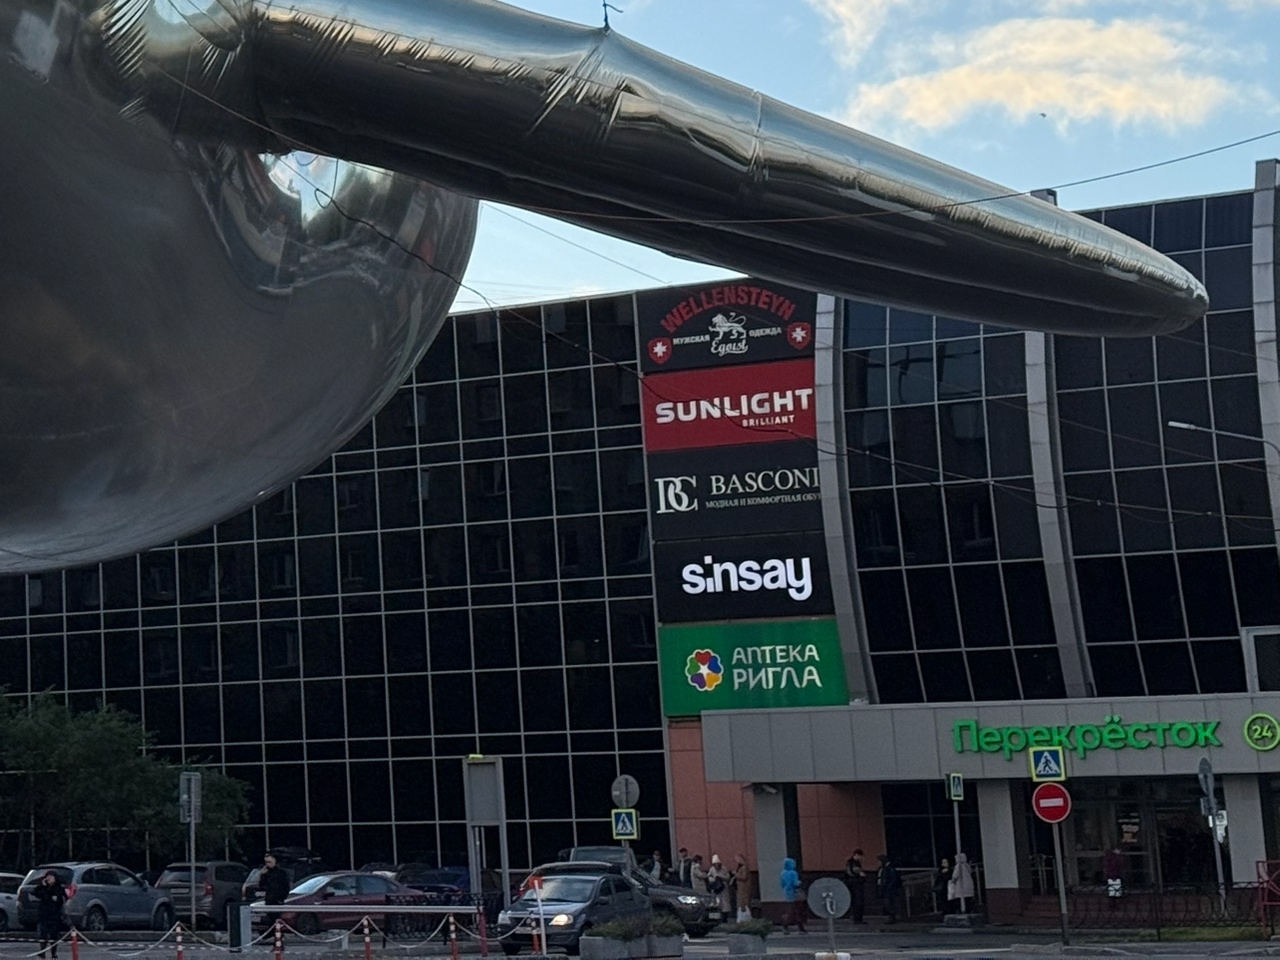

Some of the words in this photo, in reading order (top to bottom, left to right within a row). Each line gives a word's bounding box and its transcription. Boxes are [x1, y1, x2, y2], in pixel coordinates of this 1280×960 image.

[660, 285, 796, 333] WELLENSTEYN
[672, 334, 711, 345] МУЖСКАЯ
[749, 326, 782, 337] ОДЕЖДА
[655, 388, 813, 424] SUNLIGHT
[742, 414, 795, 428] BRILLIANT
[710, 467, 820, 496] BASCONI
[682, 555, 813, 601] sinsay
[731, 644, 820, 666] АПТЕКА
[732, 665, 823, 691] РИГЛА
[953, 714, 1223, 760] Перекрёсток
[1251, 724, 1274, 740] 24
